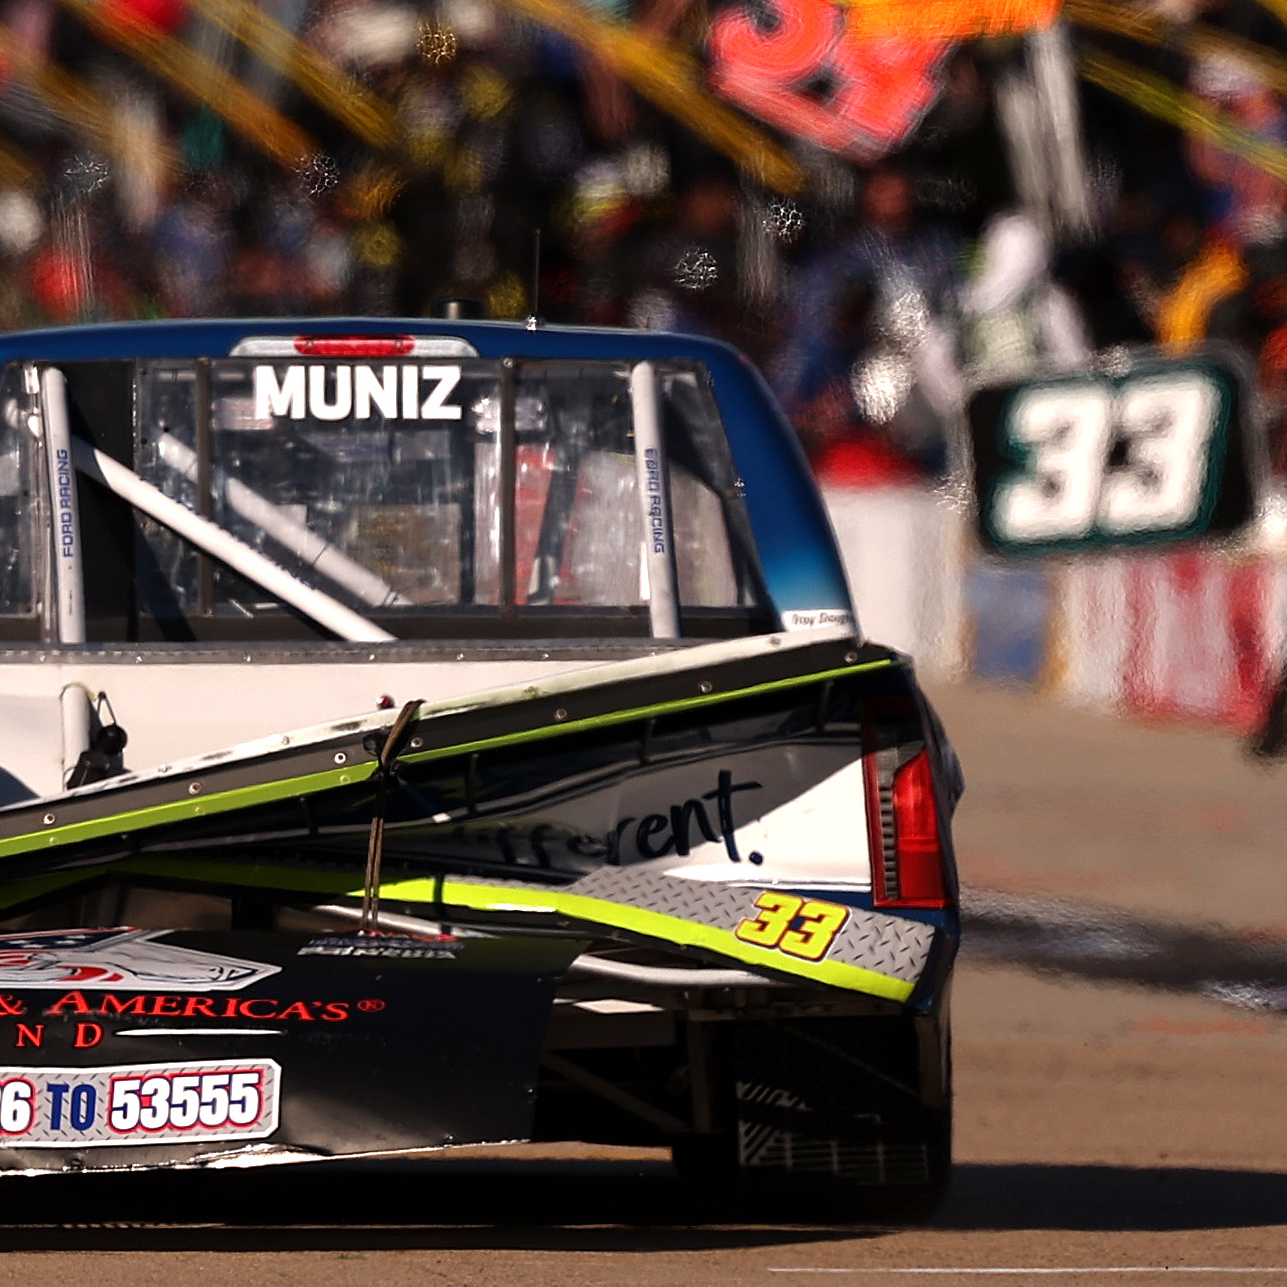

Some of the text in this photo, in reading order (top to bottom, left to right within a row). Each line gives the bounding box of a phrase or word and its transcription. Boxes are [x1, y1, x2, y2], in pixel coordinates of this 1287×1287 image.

[255, 365, 462, 421] MUNIZ
[993, 368, 1223, 542] 33
[56, 448, 74, 558] FORD RACING
[735, 891, 851, 962] 33
[47, 1083, 97, 1131] TO
[110, 1072, 262, 1132] 53555
